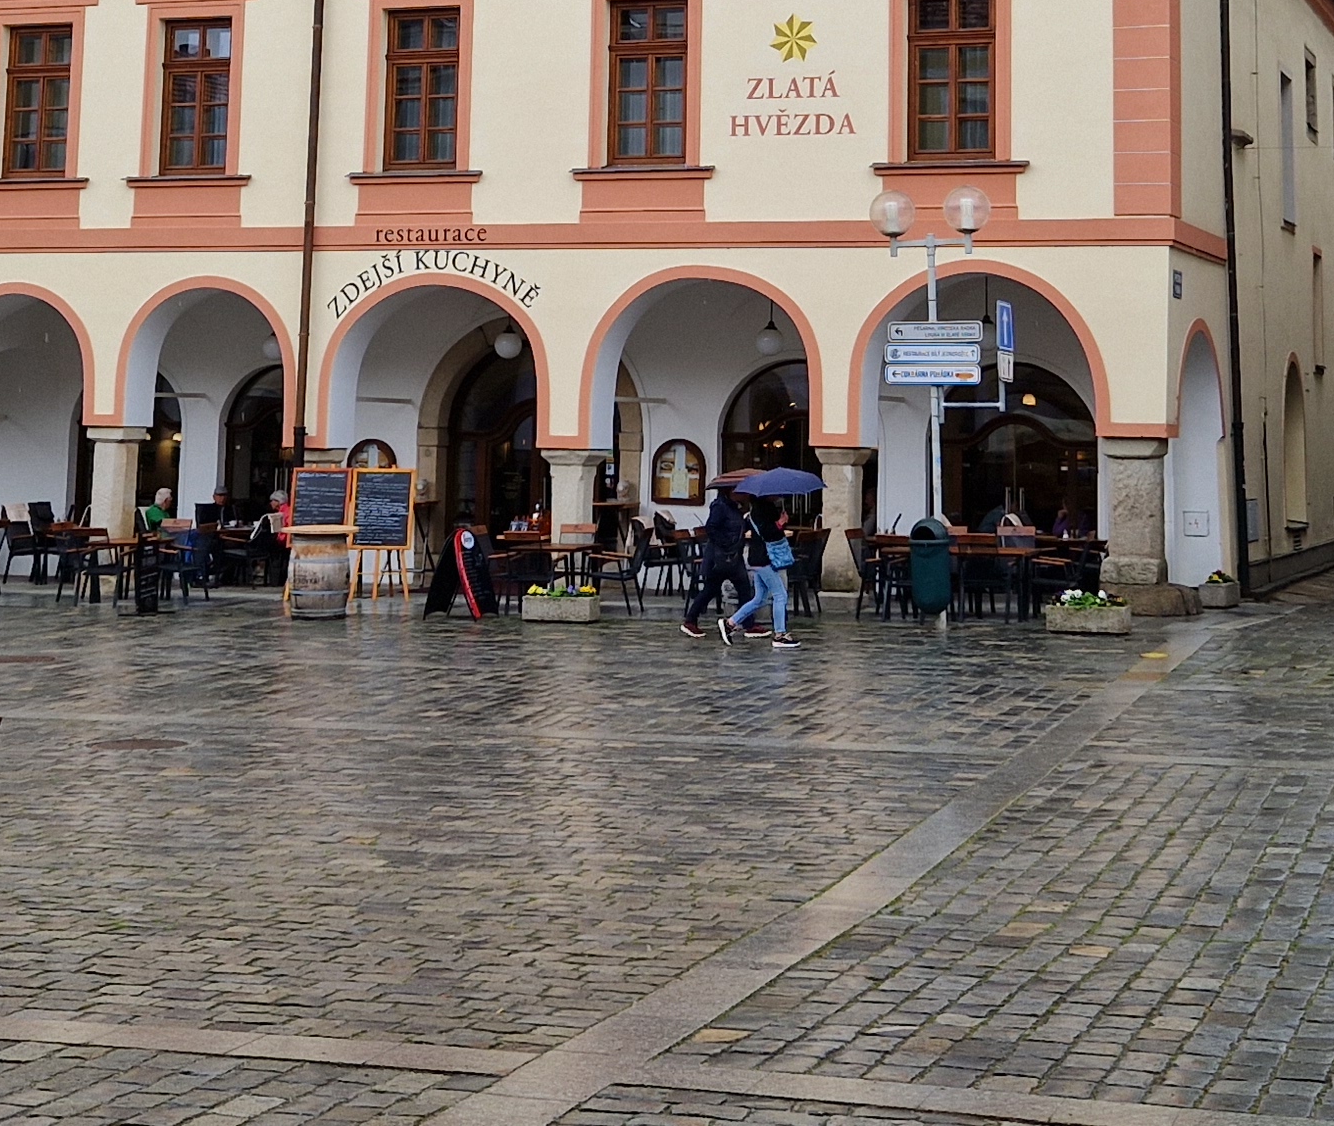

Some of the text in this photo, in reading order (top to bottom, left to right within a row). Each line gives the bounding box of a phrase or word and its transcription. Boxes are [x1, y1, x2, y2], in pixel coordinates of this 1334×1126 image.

[746, 69, 841, 100] ZLATÁ
[729, 108, 857, 137] HVĚZDA
[375, 227, 487, 243] restaurace
[327, 250, 542, 319] ZDEJŠÍ KUCHYNĚ
